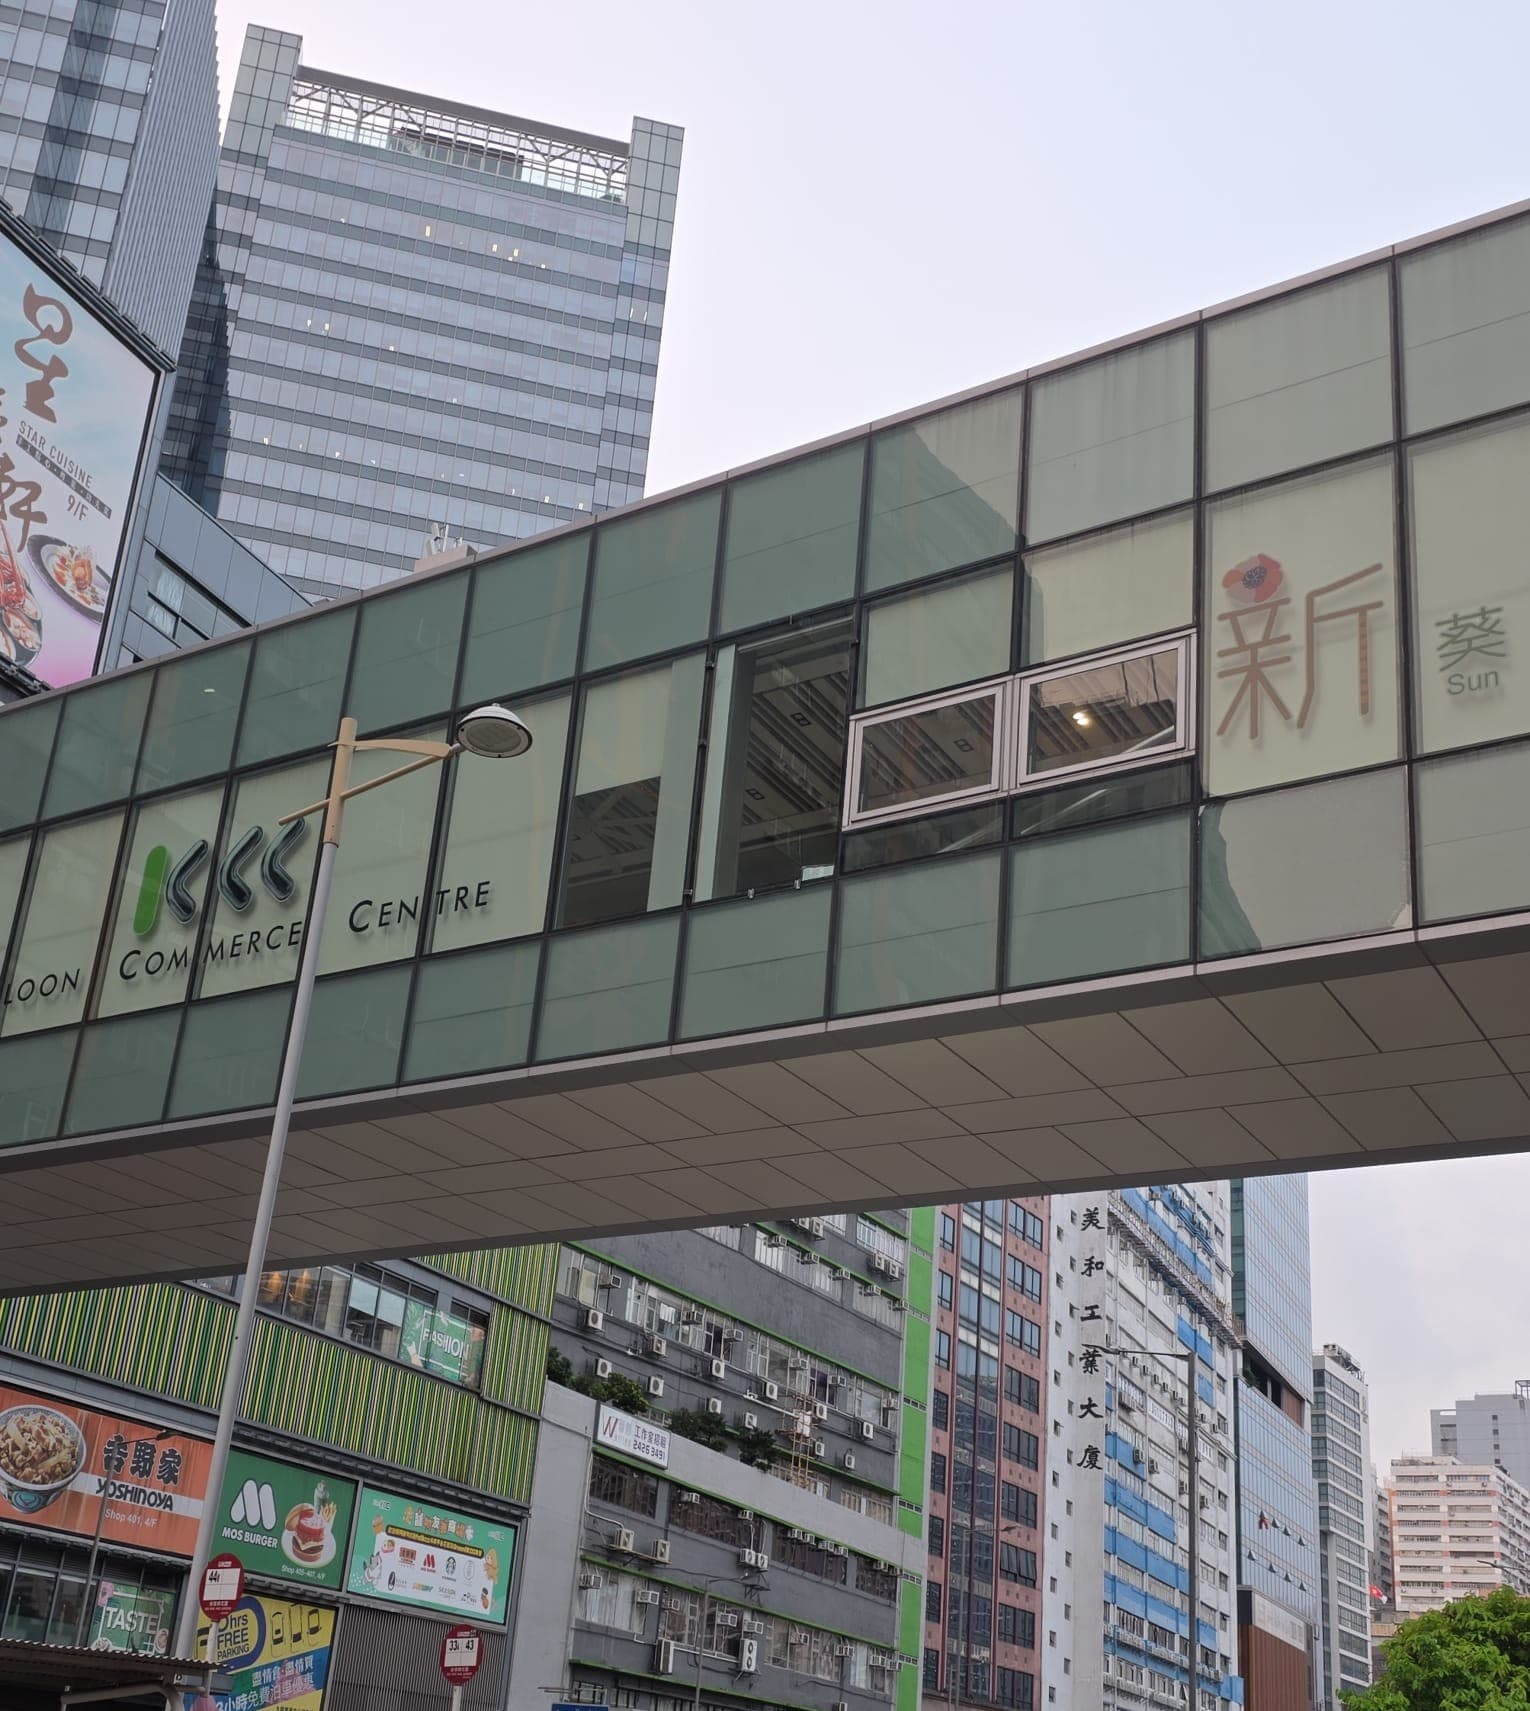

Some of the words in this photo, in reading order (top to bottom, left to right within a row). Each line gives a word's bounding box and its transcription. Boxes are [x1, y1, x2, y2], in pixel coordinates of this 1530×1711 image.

[19, 420, 47, 451] STAR
[49, 445, 94, 489] CUISINE
[67, 494, 89, 521] 9/F
[1217, 554, 1383, 740] 新
[1435, 606, 1506, 672] 葵
[1447, 669, 1499, 696] Sun
[118, 921, 303, 981] COMMERCE
[348, 881, 491, 933] CENTRE
[96, 1478, 174, 1512] YOSHINOYA
[104, 1508, 126, 1524] Shop
[222, 1526, 244, 1541] MOS
[244, 1531, 279, 1549] BURGER
[106, 1606, 159, 1635] TASTE
[217, 1627, 249, 1650] FREE
[217, 1643, 250, 1661] PARKING
